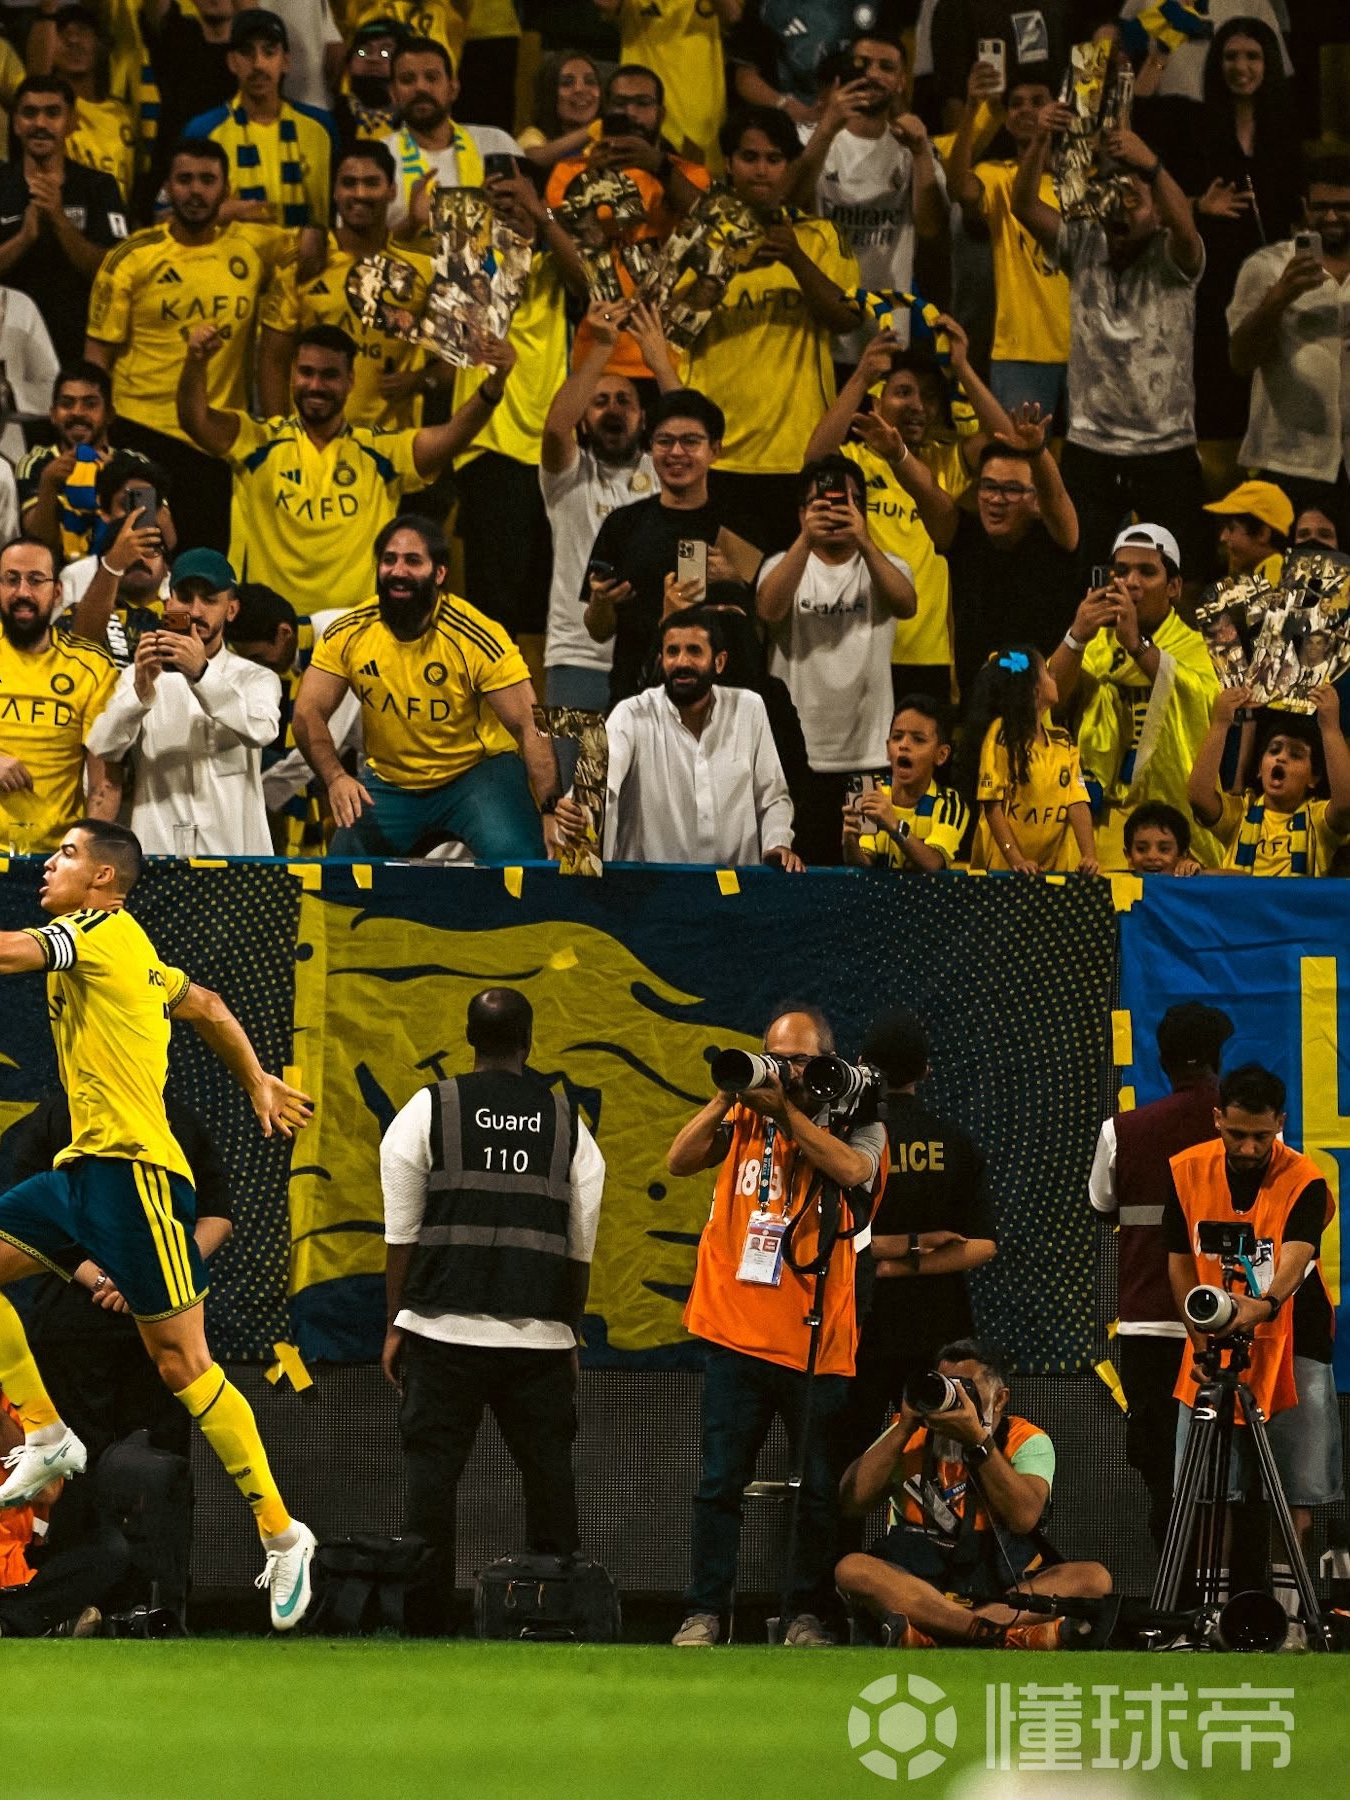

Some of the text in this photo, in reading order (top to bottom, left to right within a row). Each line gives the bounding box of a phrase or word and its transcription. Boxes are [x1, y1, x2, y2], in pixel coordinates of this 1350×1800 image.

[161, 295, 250, 320] KAFD
[275, 489, 358, 520] KAFD
[360, 685, 450, 722] KAFD
[1008, 803, 1068, 824] KAFD
[475, 1108, 541, 1133] Guard
[483, 1147, 529, 1173] 110
[888, 1141, 945, 1174] LICE
